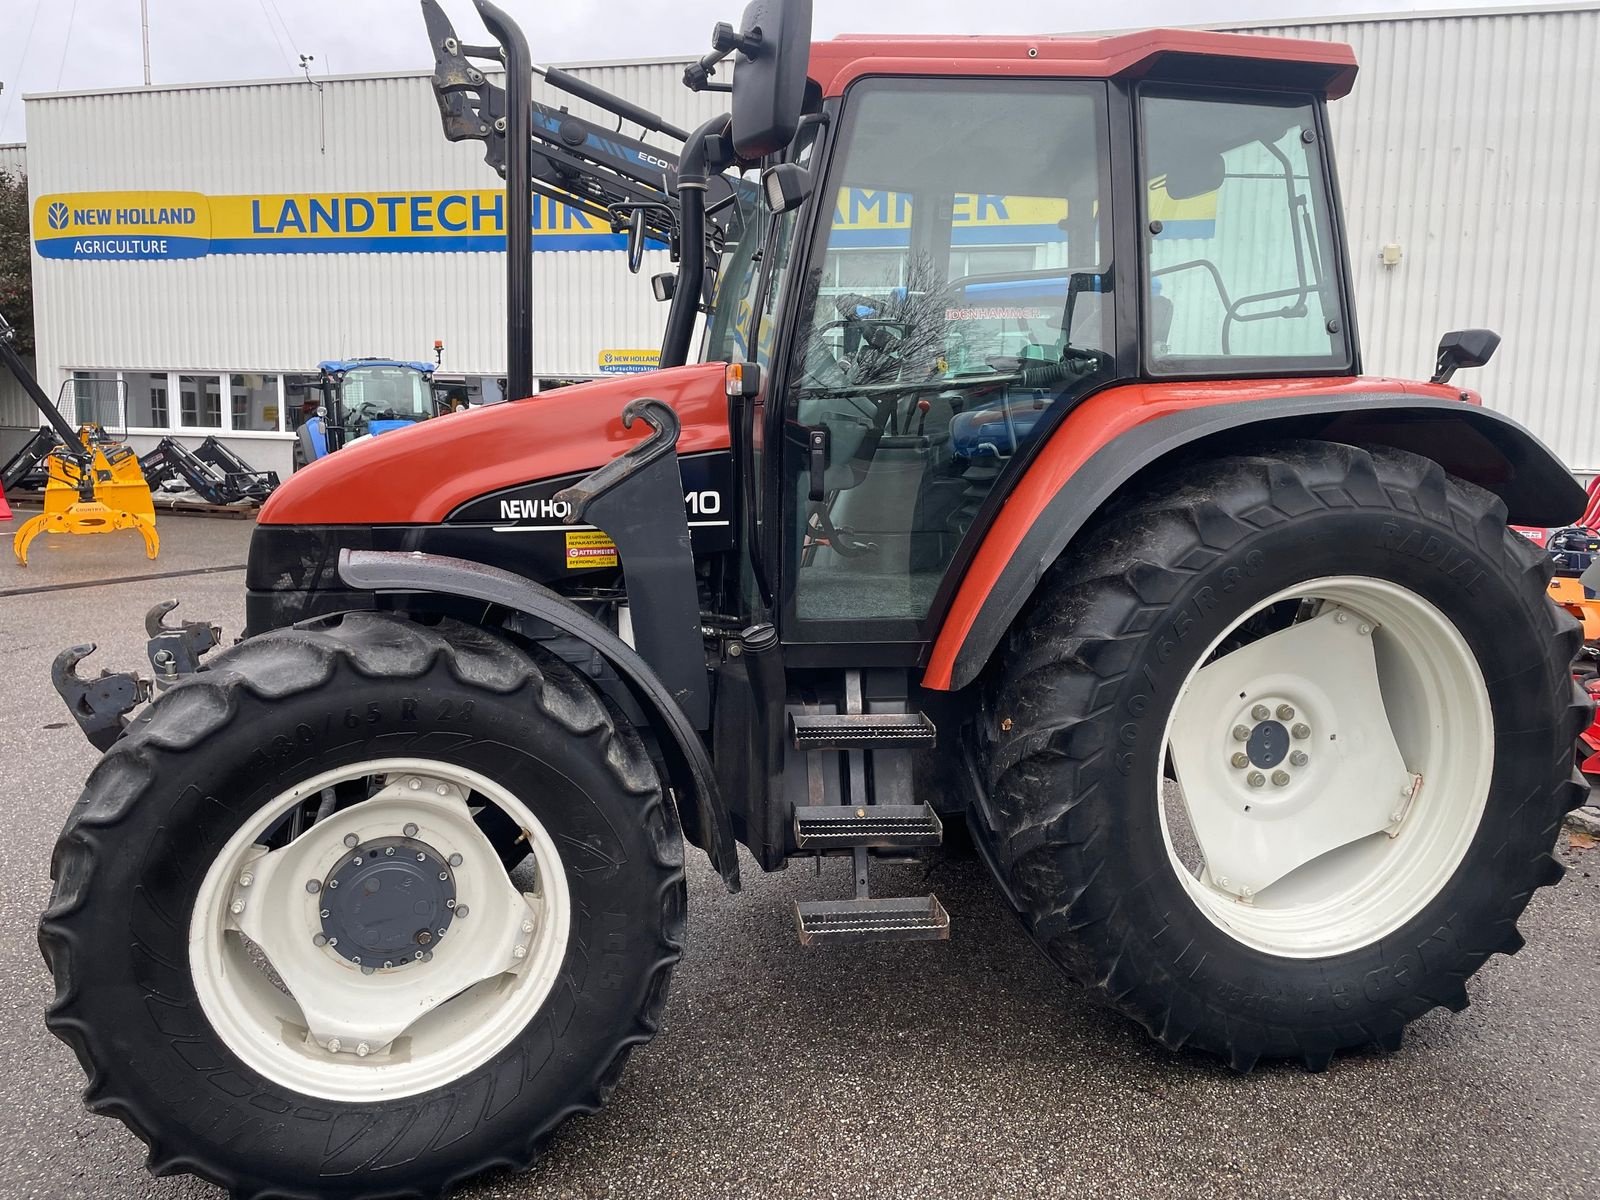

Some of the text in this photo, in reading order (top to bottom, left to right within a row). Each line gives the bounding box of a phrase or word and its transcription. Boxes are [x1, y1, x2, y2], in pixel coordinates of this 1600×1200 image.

[74, 207, 196, 225] NEW HOLLAND
[74, 240, 168, 254] AGRICULTURE
[501, 500, 539, 518] NEW
